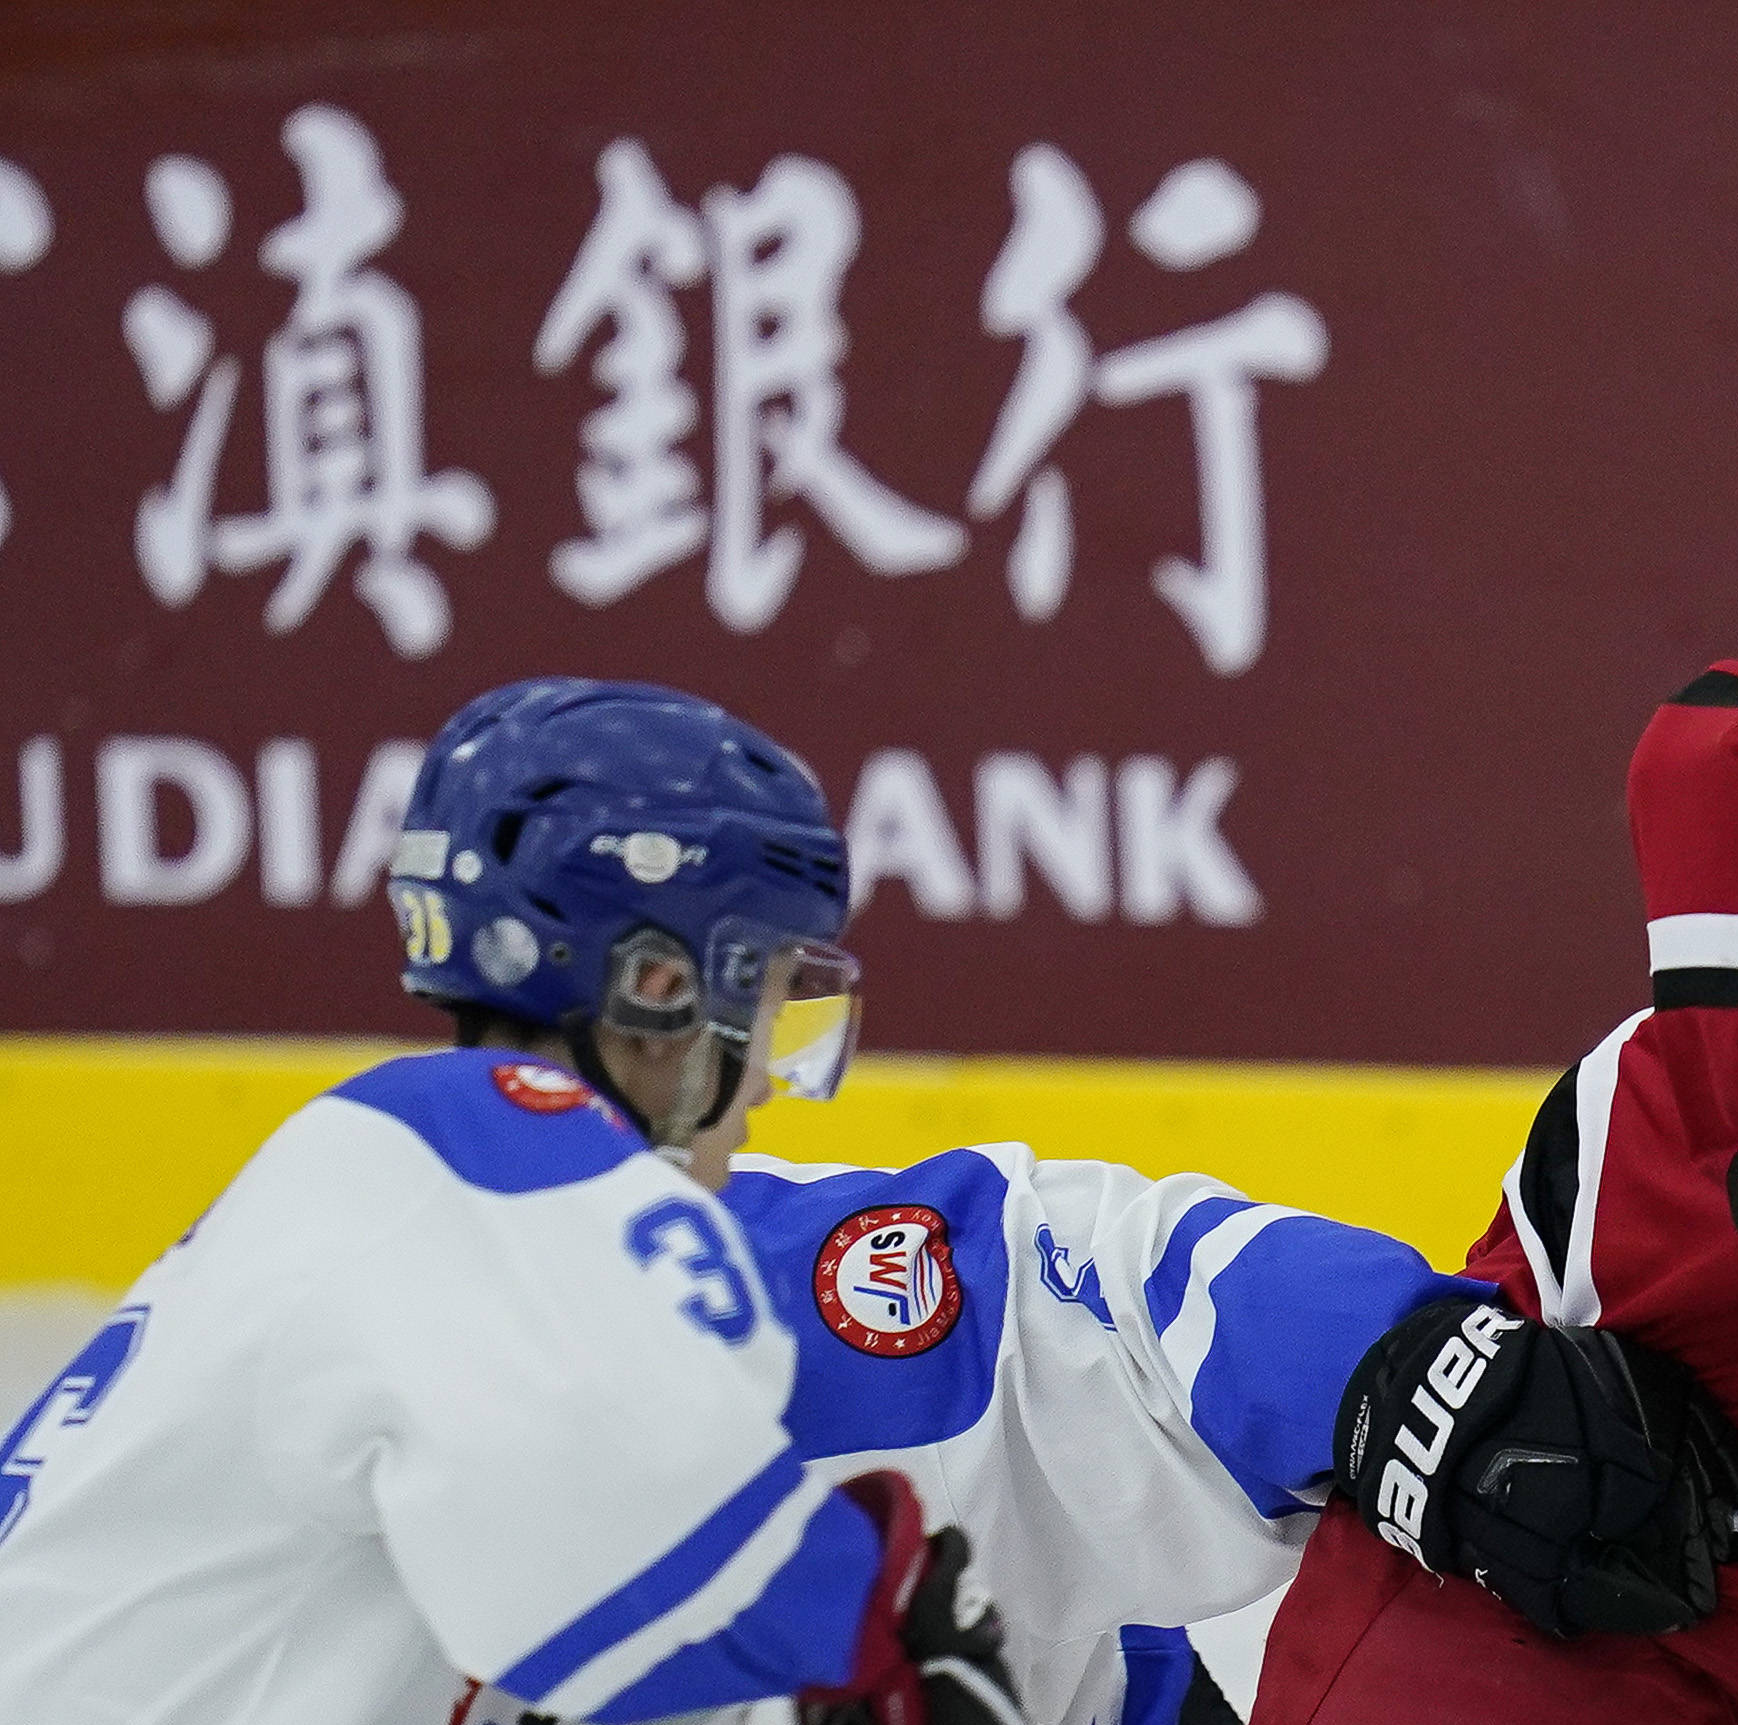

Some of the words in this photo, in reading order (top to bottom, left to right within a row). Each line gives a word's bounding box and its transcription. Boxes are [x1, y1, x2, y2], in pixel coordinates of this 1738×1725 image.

[0, 104, 1328, 675] 滇銀行
[850, 749, 1263, 925] ANK
[623, 1196, 756, 1349] 3
